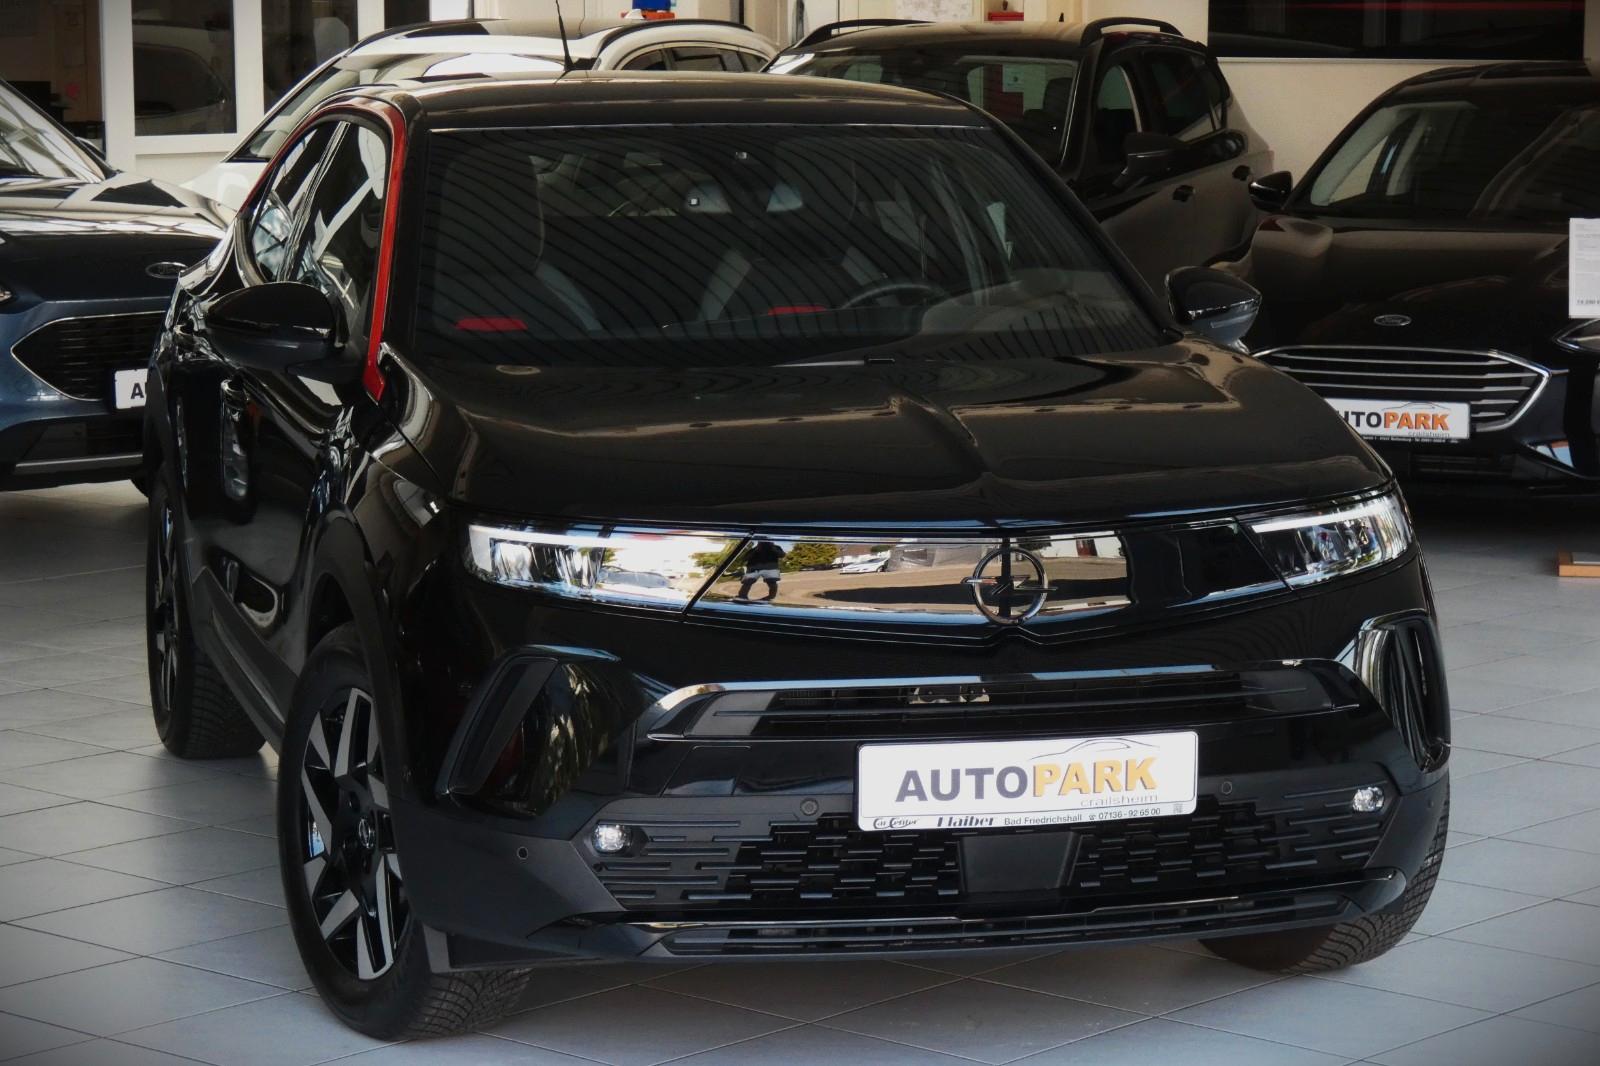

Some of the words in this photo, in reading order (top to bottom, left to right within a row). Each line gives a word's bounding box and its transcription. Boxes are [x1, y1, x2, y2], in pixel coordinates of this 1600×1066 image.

[1336, 410, 1450, 431] TOPARK
[894, 756, 1159, 803] AUTOPARK
[1080, 794, 1158, 808] crailsheim
[1004, 816, 1022, 826] Bad
[1024, 813, 1083, 825] Friedrichshall
[1151, 807, 1161, 816] 00
